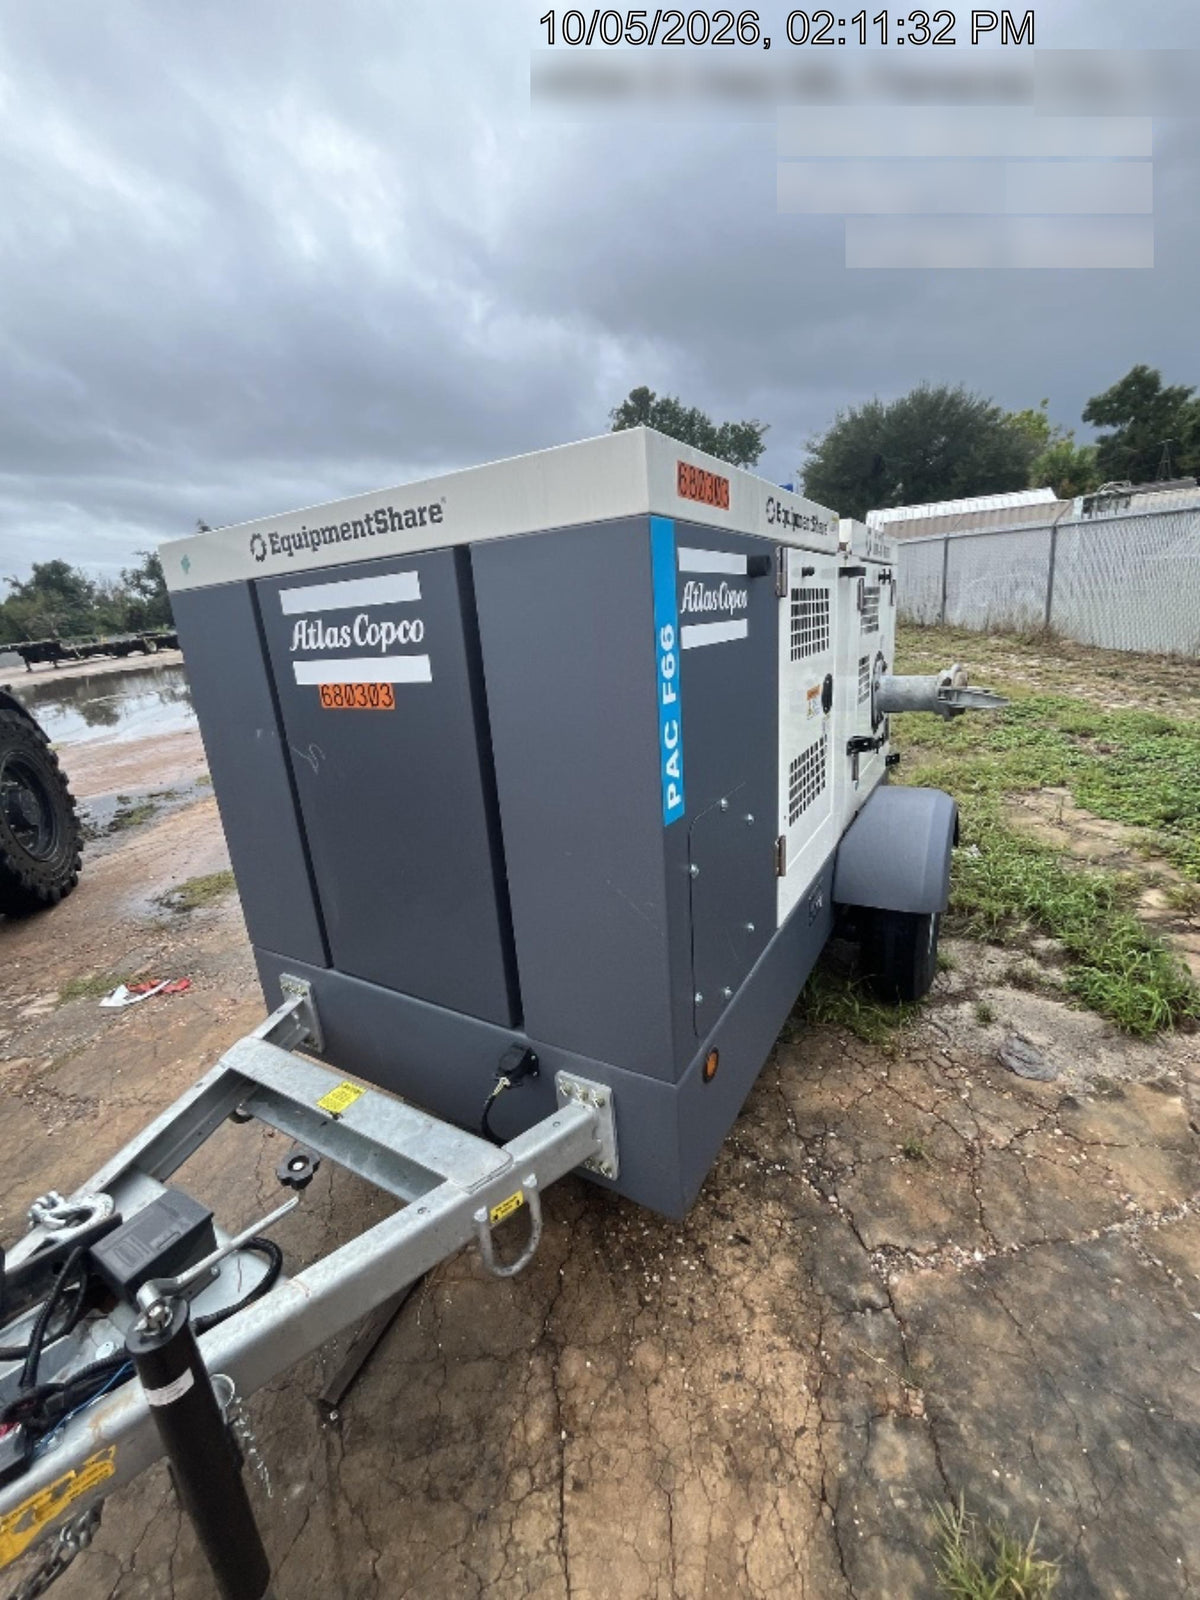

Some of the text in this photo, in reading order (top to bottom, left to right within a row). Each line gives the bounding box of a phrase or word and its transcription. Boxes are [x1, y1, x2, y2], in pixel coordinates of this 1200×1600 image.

[269, 502, 443, 557] EquipmentShare
[321, 683, 394, 707] 680303
[660, 623, 682, 810] PAC F66
